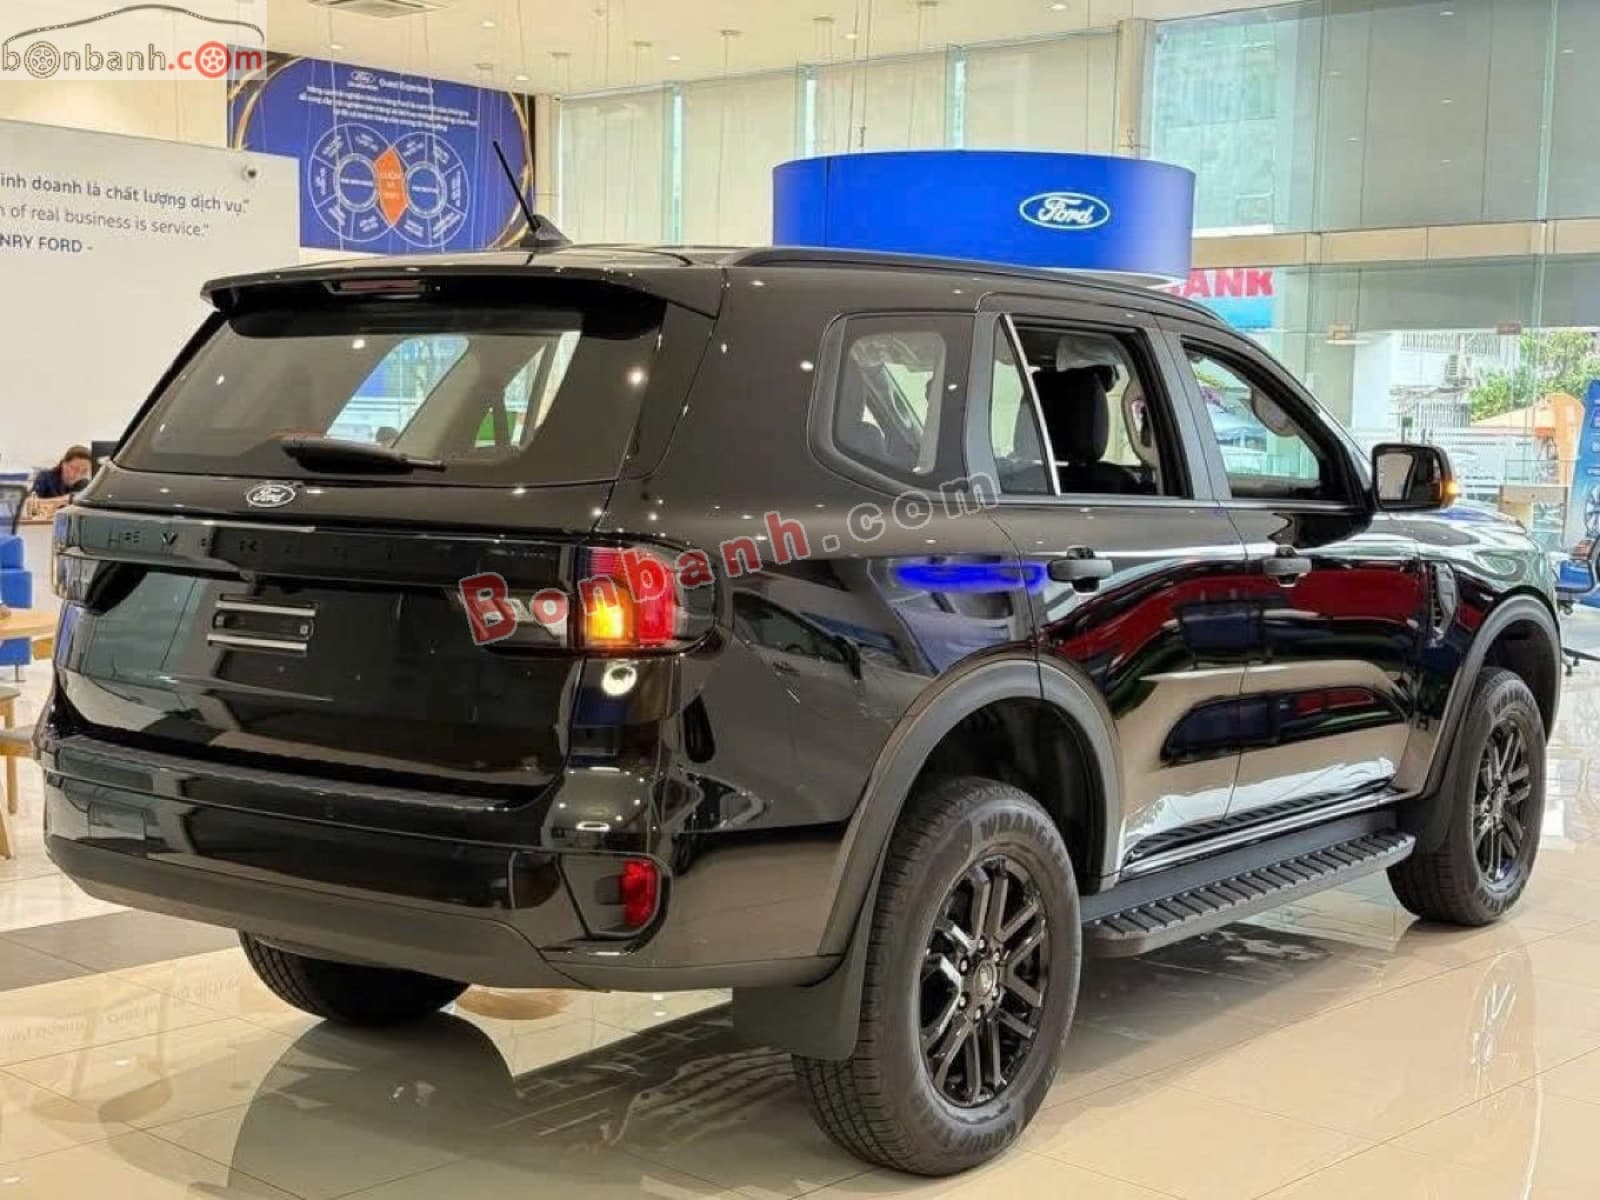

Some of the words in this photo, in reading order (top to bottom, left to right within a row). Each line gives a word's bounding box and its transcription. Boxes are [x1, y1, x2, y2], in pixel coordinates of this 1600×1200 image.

[32, 175, 81, 193] doanh
[105, 186, 140, 201] chất
[144, 188, 186, 209] lượng
[191, 194, 221, 212] dịch
[11, 203, 26, 218] of
[31, 206, 60, 222] real
[65, 208, 131, 229] business
[135, 215, 147, 231] is
[1034, 195, 1098, 225] Ford
[39, 235, 82, 253] FORD
[1168, 267, 1273, 298] ANK
